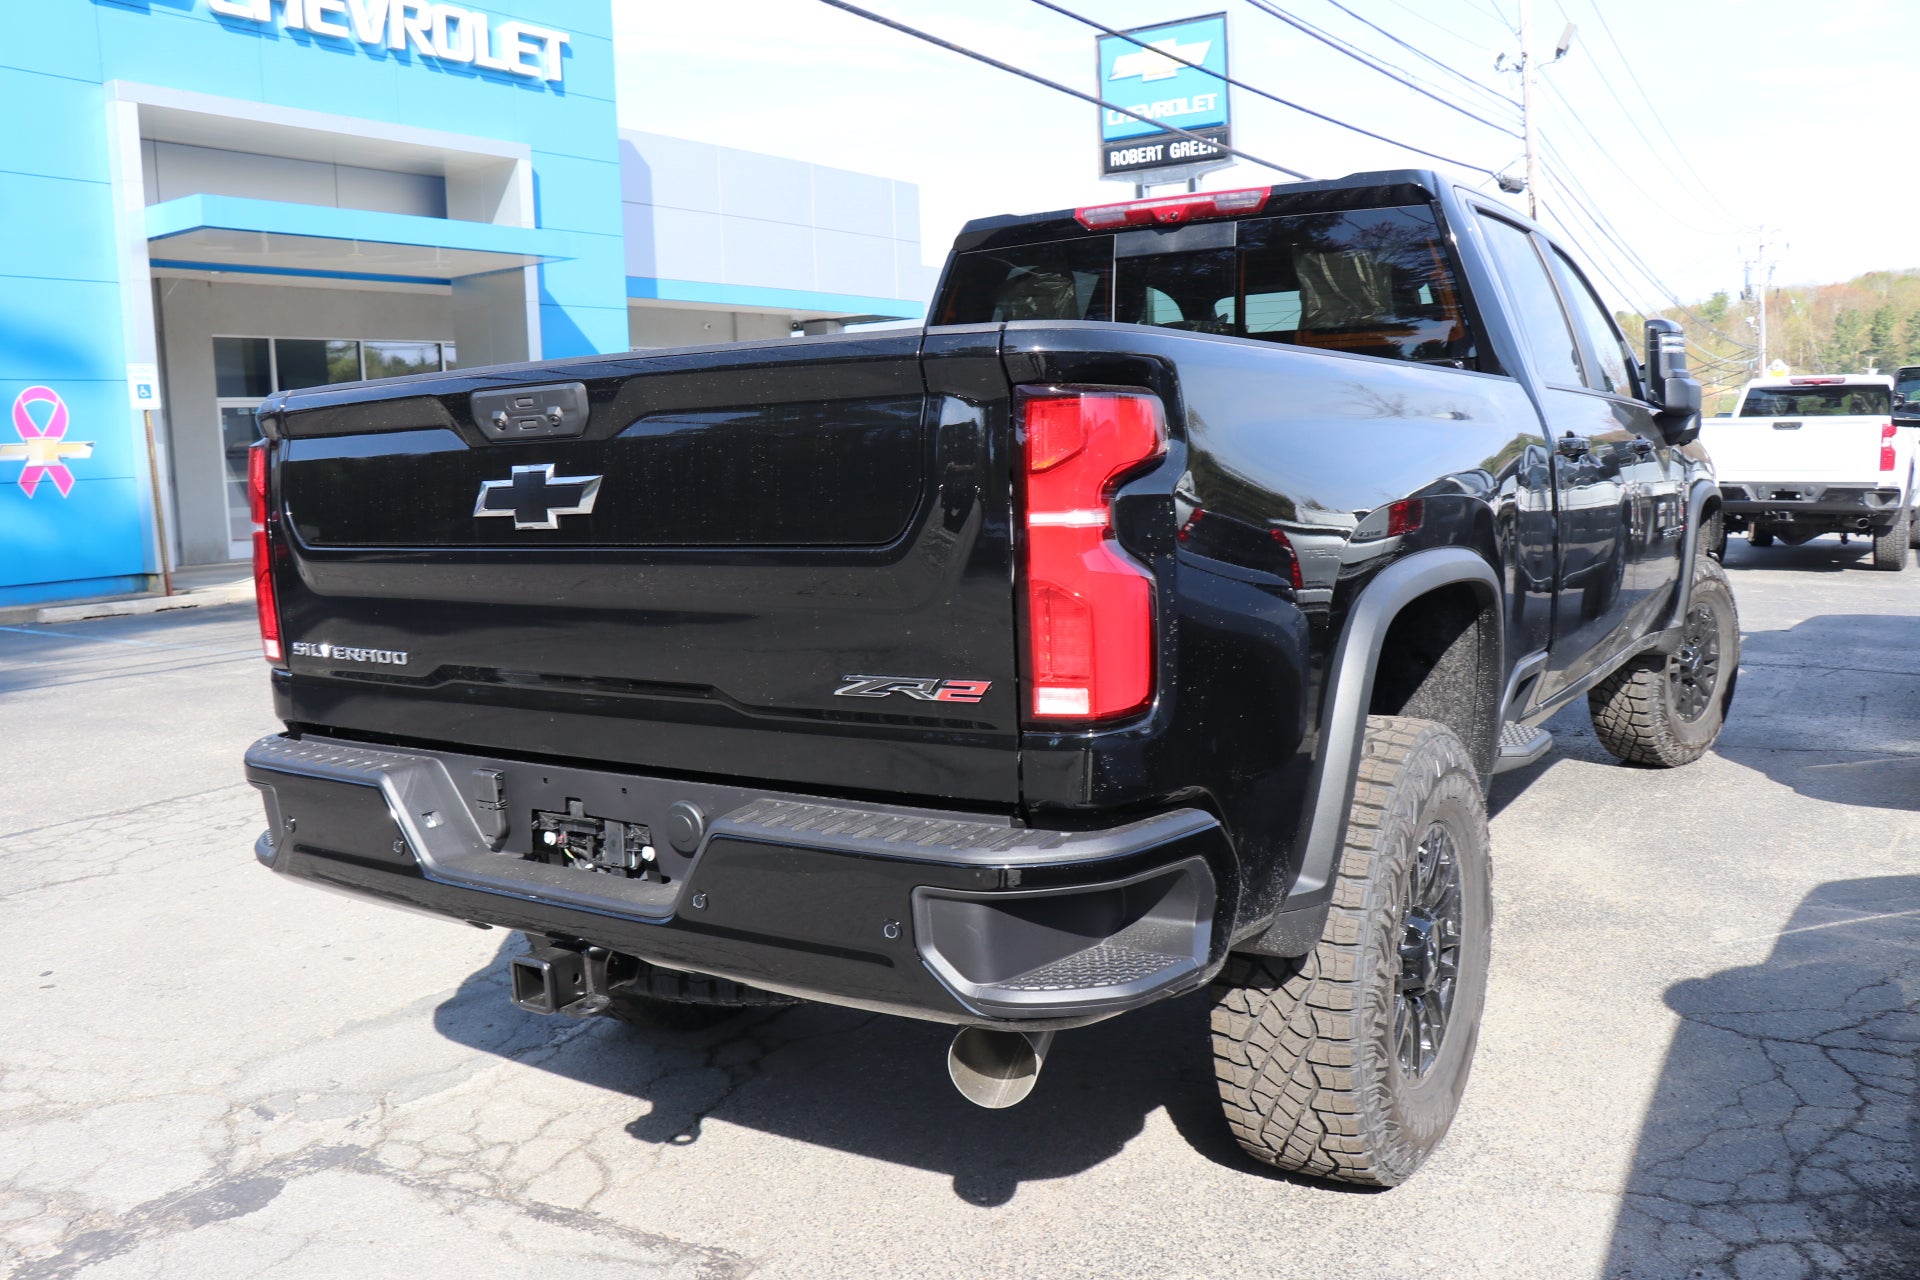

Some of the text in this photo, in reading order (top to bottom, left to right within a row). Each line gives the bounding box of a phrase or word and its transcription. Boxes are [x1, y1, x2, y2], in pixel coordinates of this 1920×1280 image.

[1110, 144, 1164, 167] ROBERT
[292, 641, 408, 665] SILVERADO
[834, 674, 992, 703] ZR2
